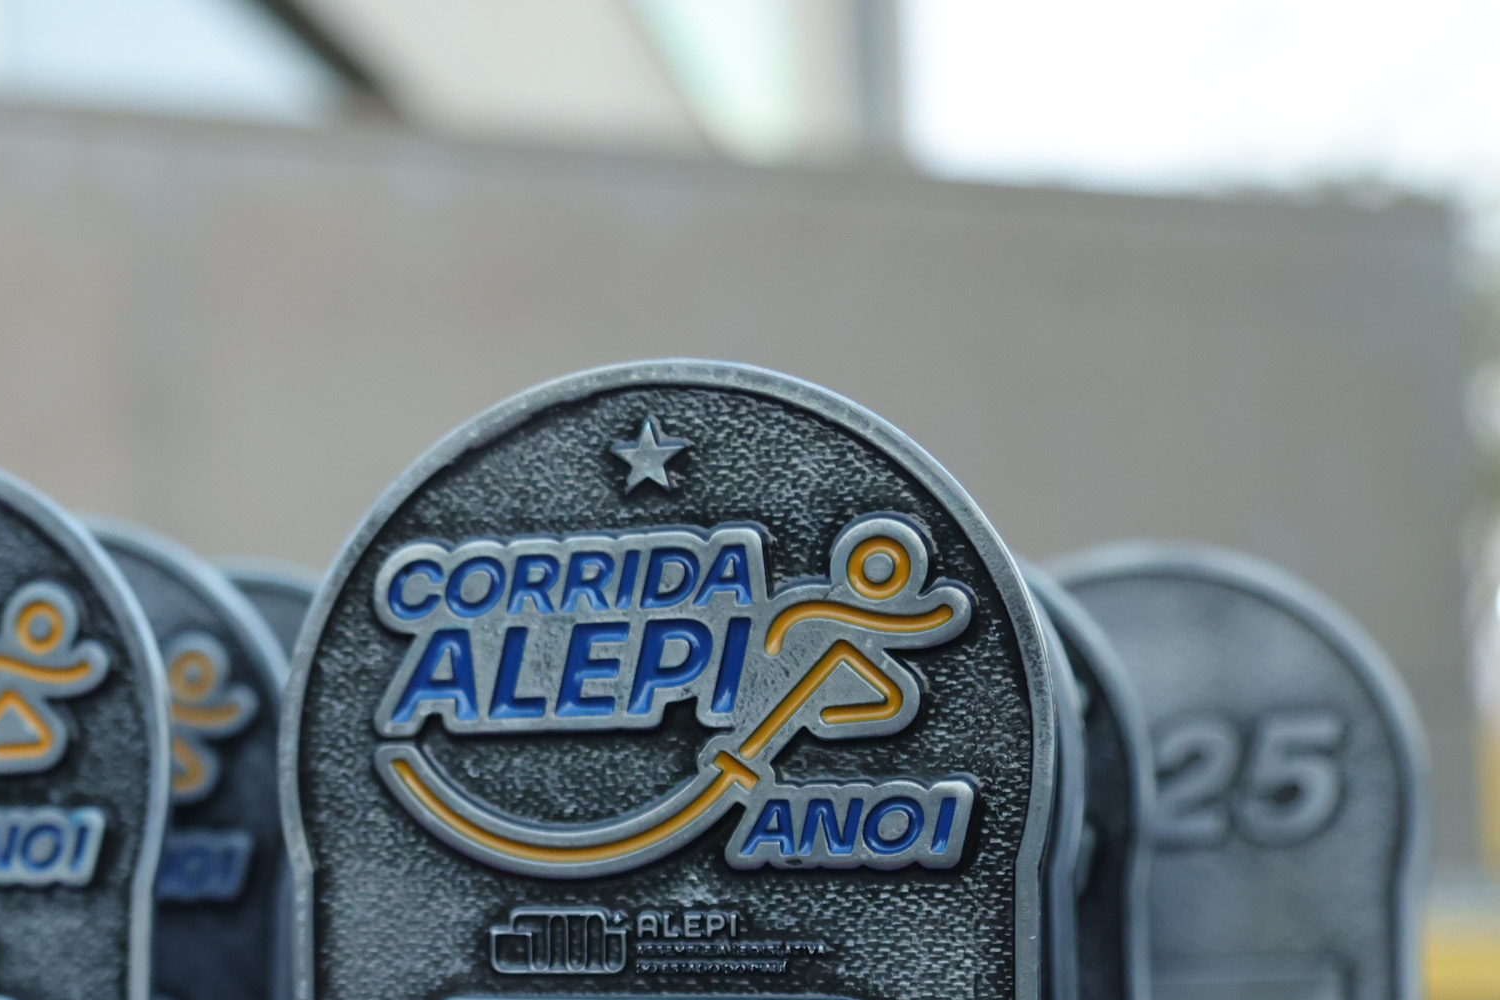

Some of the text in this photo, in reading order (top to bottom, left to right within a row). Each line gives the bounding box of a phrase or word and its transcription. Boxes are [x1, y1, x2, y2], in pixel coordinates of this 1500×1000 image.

[388, 543, 753, 621] CORRIDA
[391, 616, 752, 726] ALEPI
[637, 911, 740, 938] ALEPI
